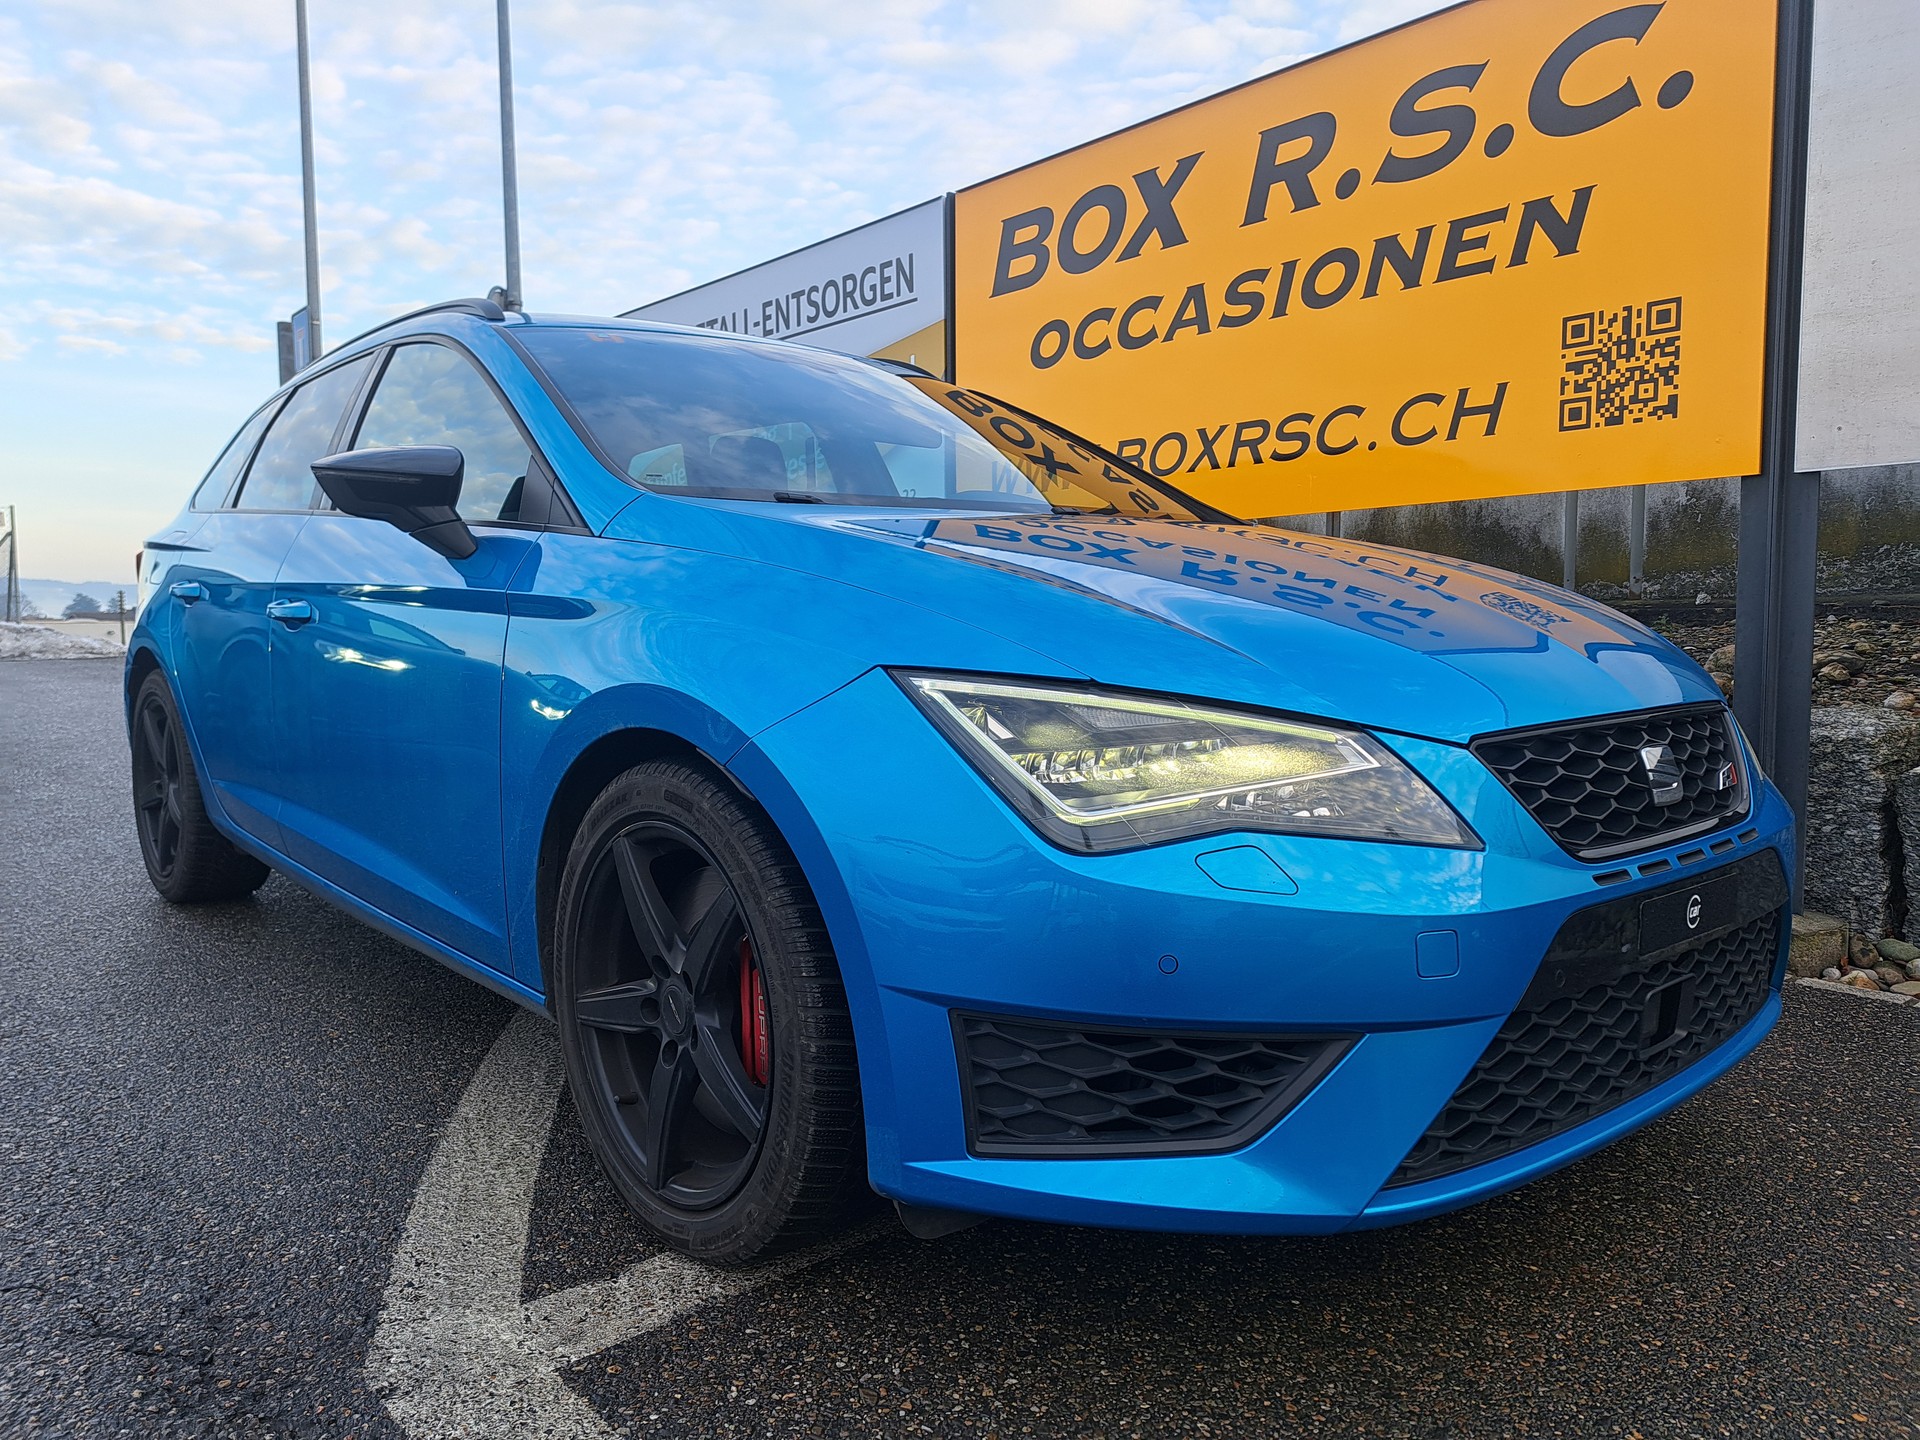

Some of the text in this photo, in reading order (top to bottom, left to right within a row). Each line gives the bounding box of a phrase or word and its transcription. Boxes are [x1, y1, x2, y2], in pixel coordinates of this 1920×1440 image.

[988, 1, 1695, 299] BOX R.S.C.
[1030, 184, 1598, 370] OCCASIONEN
